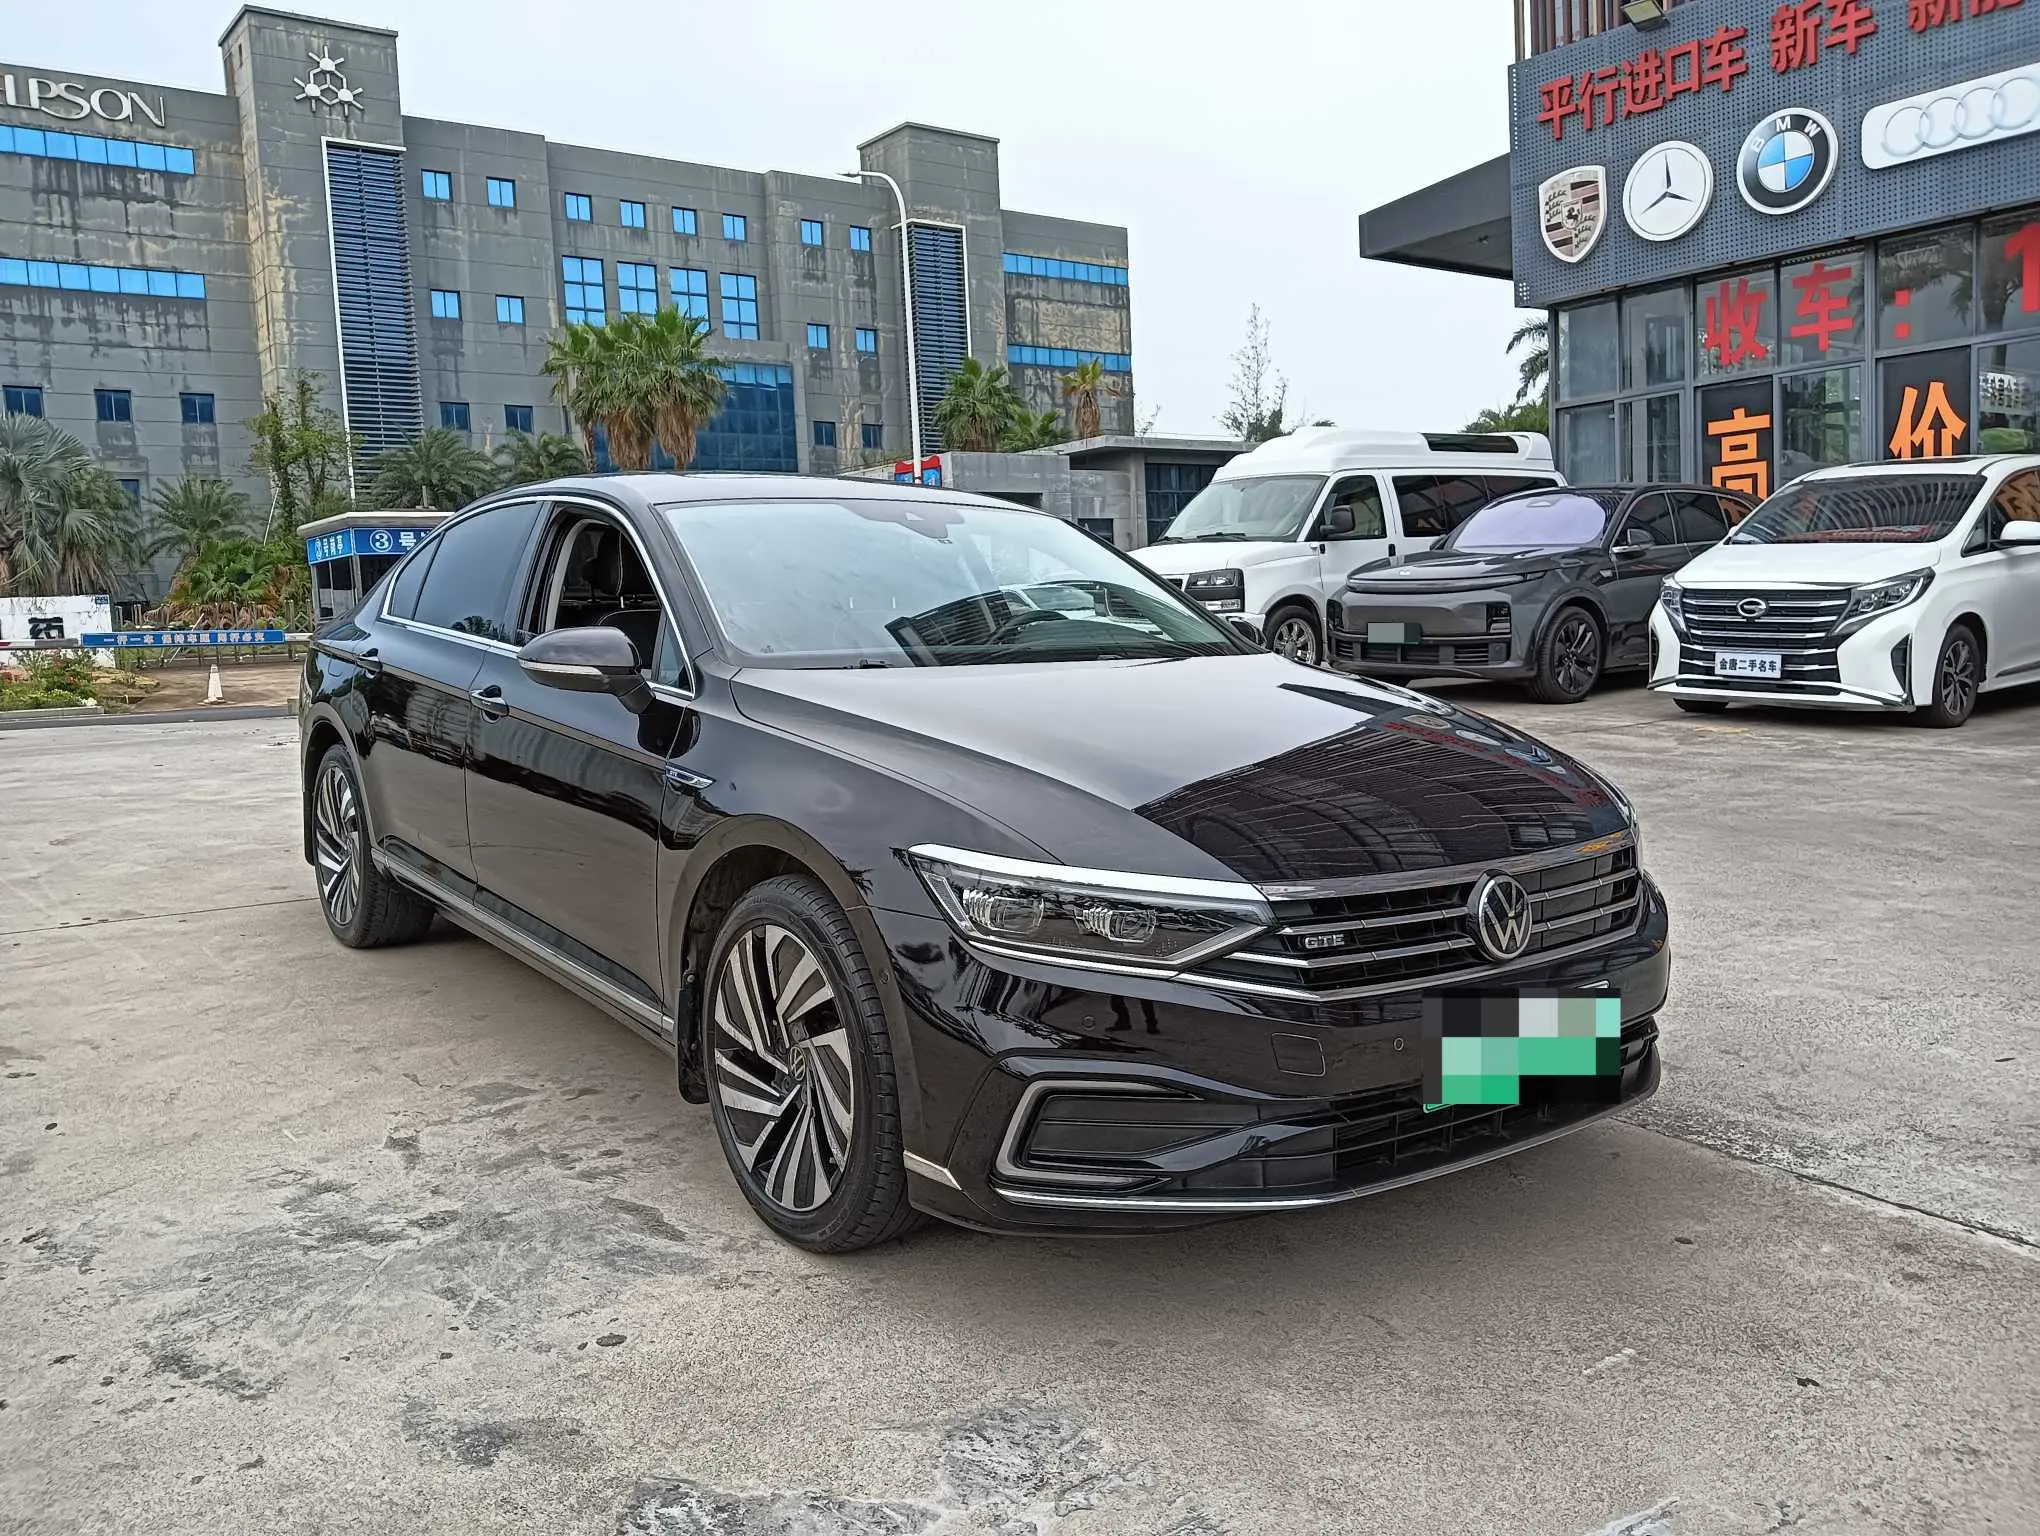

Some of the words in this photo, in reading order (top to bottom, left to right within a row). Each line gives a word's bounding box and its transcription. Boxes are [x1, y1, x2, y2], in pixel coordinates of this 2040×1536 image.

[1537, 24, 1748, 140] 平行进口车
[1770, 0, 1877, 74] 新车
[0, 74, 165, 128] LPSON
[1750, 115, 1821, 154] BMW
[1304, 933, 1345, 949] GTE
